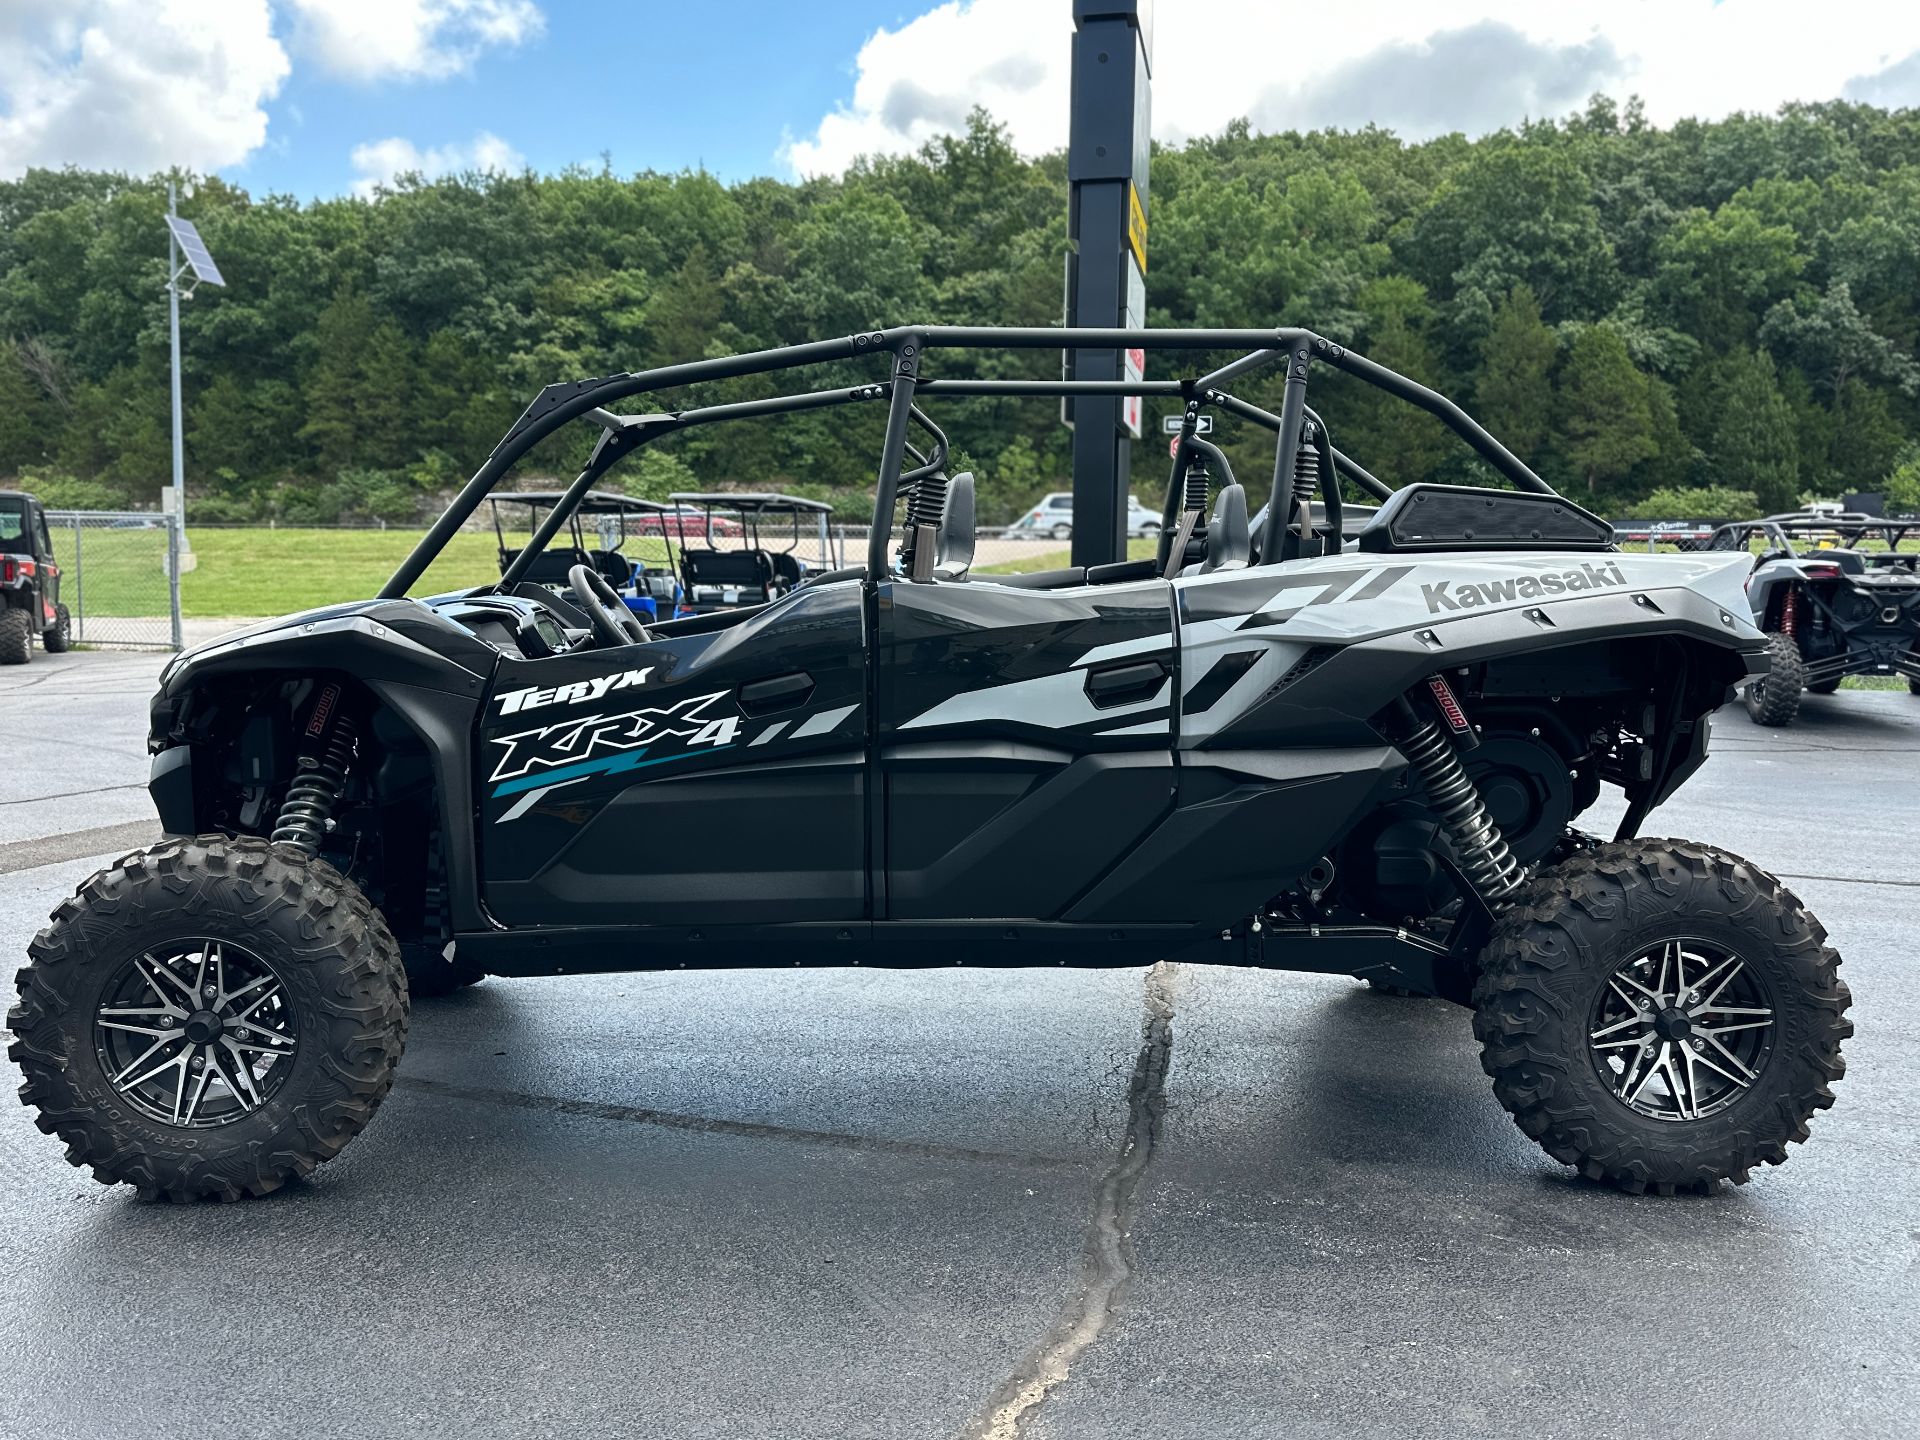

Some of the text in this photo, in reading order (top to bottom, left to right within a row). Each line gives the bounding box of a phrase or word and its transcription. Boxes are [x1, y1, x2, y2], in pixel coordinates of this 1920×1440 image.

[1420, 560, 1628, 614] Kawasaki
[310, 687, 337, 735] SHOWA
[494, 666, 655, 716] TERYX
[1429, 680, 1468, 729] SHOWA
[87, 1087, 198, 1149] CARNIVORE
